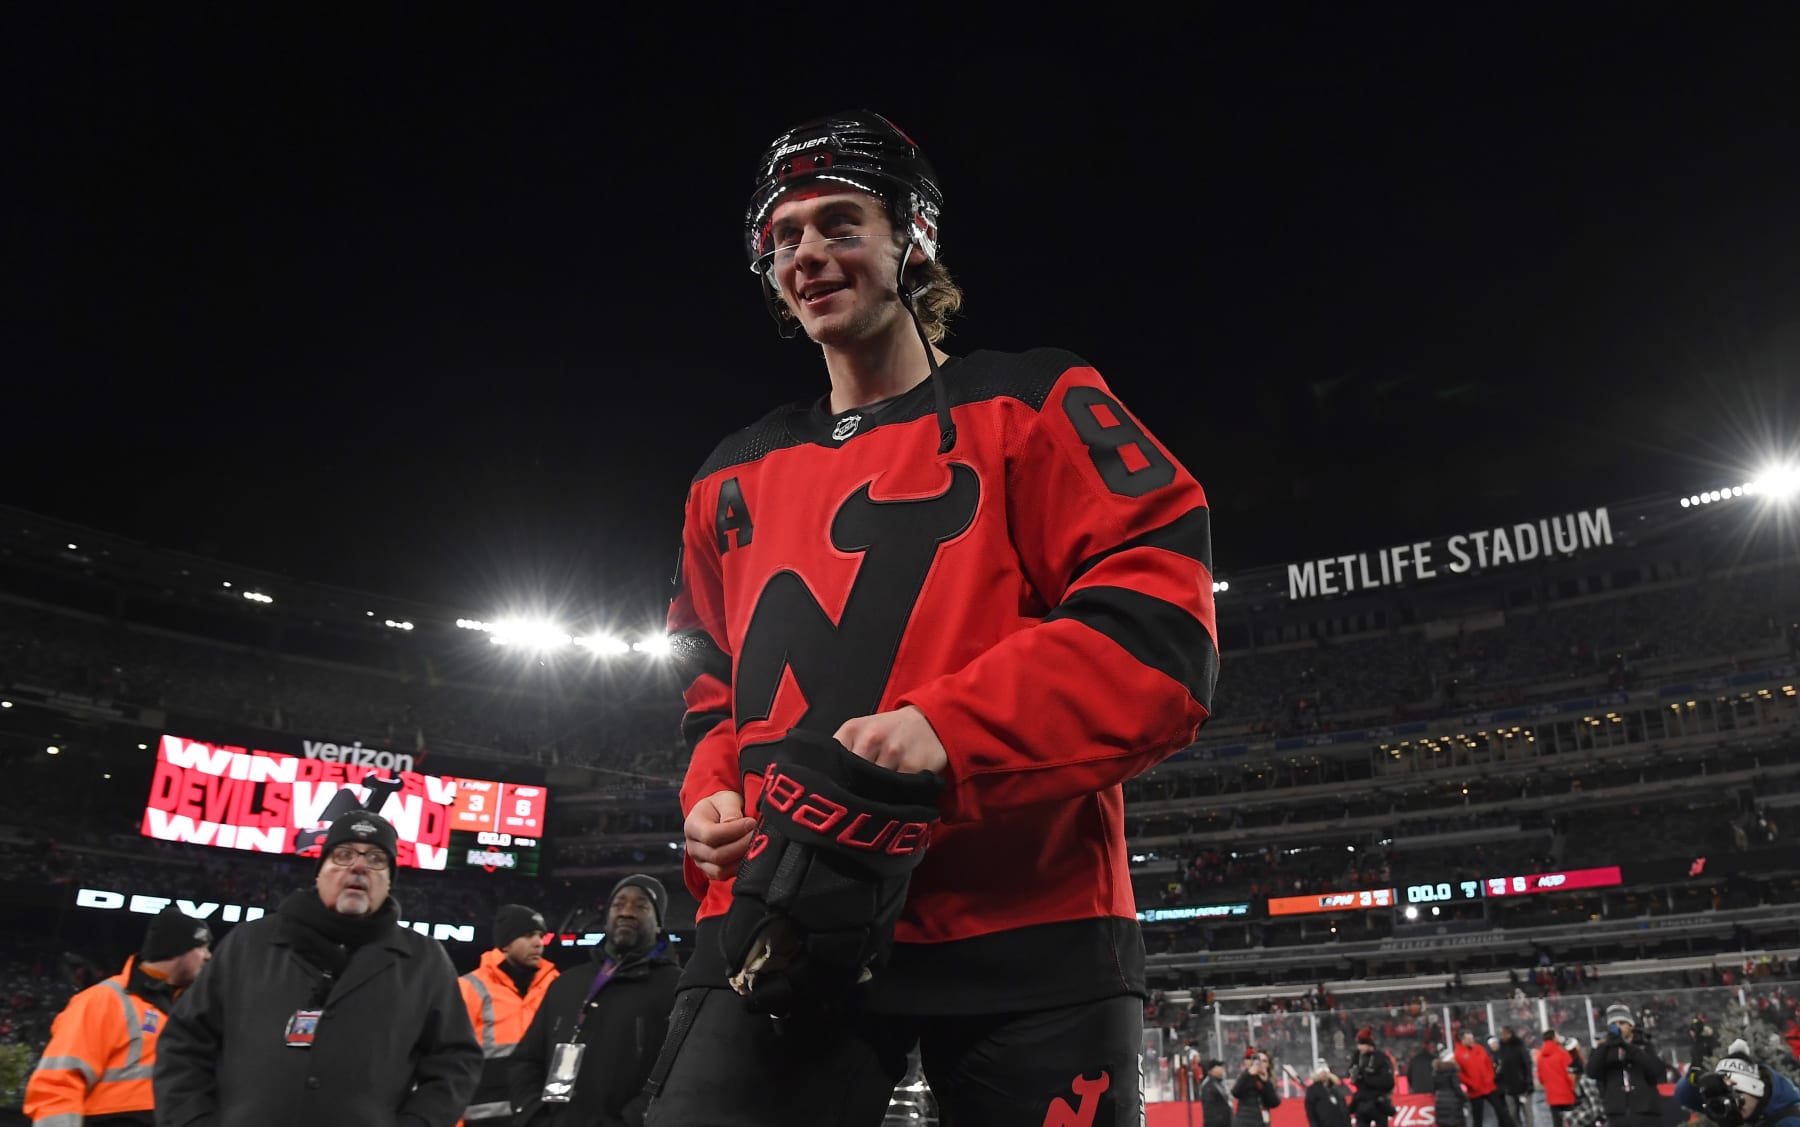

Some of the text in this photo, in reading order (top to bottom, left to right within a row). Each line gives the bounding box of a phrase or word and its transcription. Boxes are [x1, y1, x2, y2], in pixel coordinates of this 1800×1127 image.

[1062, 385, 1176, 498] 8
[715, 477, 754, 554] A
[1287, 507, 1613, 600] METLIFE STADIUM
[162, 734, 299, 784] WIN
[299, 758, 424, 796] DEVS
[303, 740, 414, 772] verizon
[149, 760, 293, 828] DEVILS
[468, 794, 485, 812] 3
[147, 806, 286, 854] WIN
[1360, 891, 1372, 906] 3
[1407, 883, 1452, 903] 00.0
[1387, 1105, 1435, 1126] ILS
